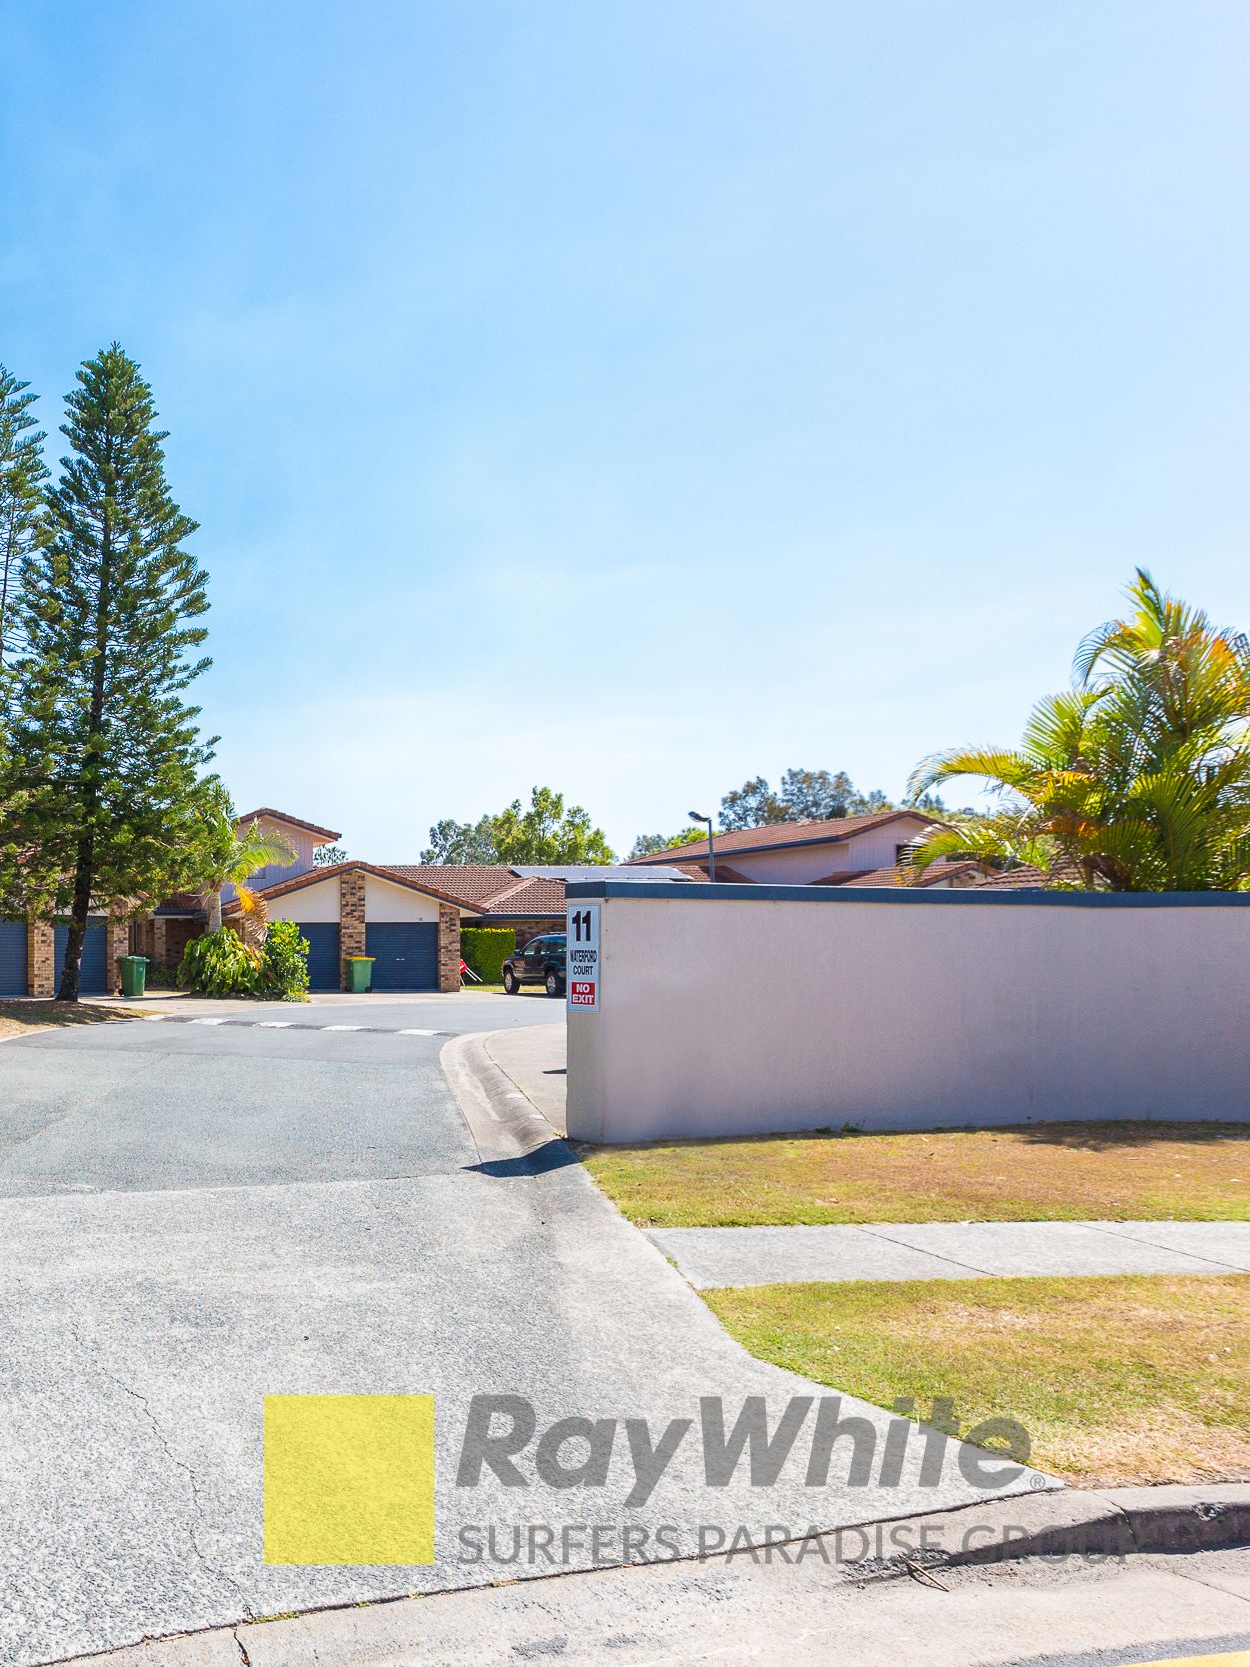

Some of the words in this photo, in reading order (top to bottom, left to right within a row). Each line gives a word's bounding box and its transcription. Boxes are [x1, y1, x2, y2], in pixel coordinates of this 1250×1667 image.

[572, 910, 592, 942] 11
[570, 949, 598, 963] WATERFORD
[573, 965, 594, 975] COURT
[576, 984, 590, 993] NO
[572, 994, 594, 1004] EXIT
